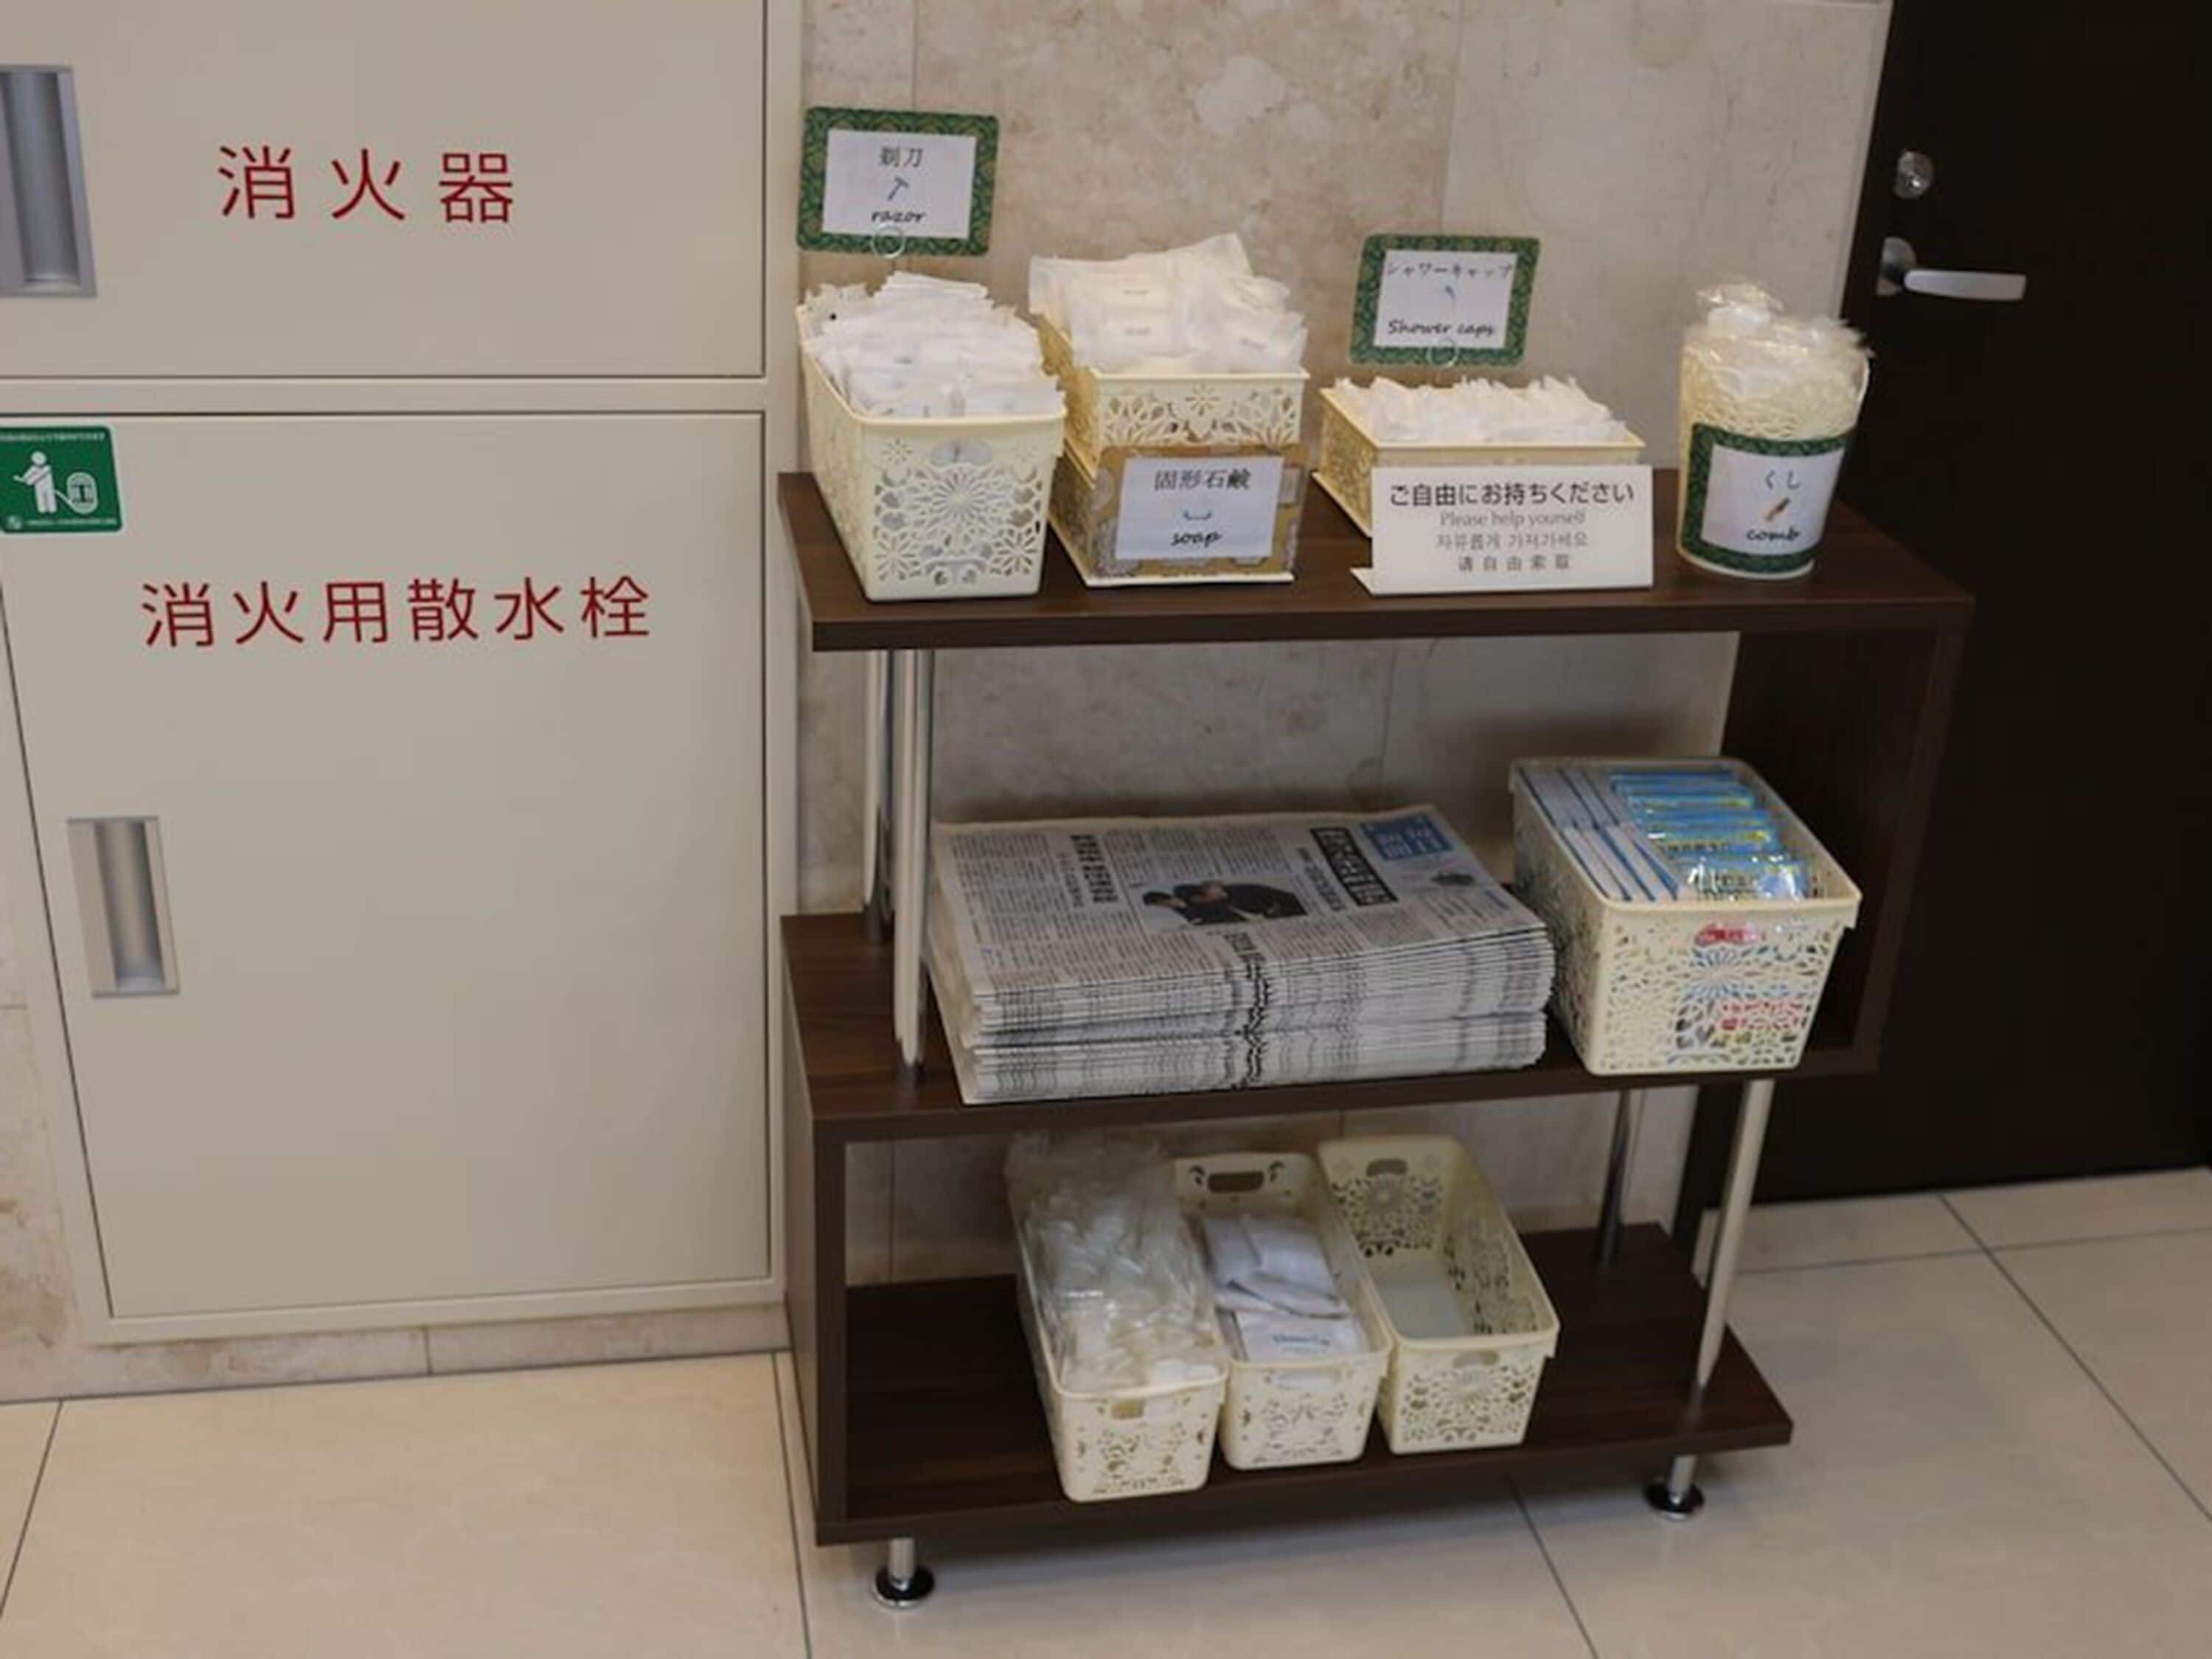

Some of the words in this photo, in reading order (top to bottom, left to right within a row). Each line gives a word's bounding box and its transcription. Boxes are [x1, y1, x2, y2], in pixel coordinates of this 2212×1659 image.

[218, 146, 514, 223] 消火器
[872, 209, 925, 222] razor
[1388, 319, 1452, 335] Shower
[1457, 323, 1493, 338] caps
[1764, 470, 1801, 490] くし
[1390, 481, 1634, 507] ご自由にお持ちください
[1440, 512, 1488, 526] Please
[1491, 512, 1525, 529] help
[1528, 511, 1585, 529] yourself
[1171, 531, 1222, 548] soap
[1509, 532, 1588, 549] 가져가세요
[1746, 526, 1801, 541] comb
[141, 575, 650, 647] 消火用散水栓
